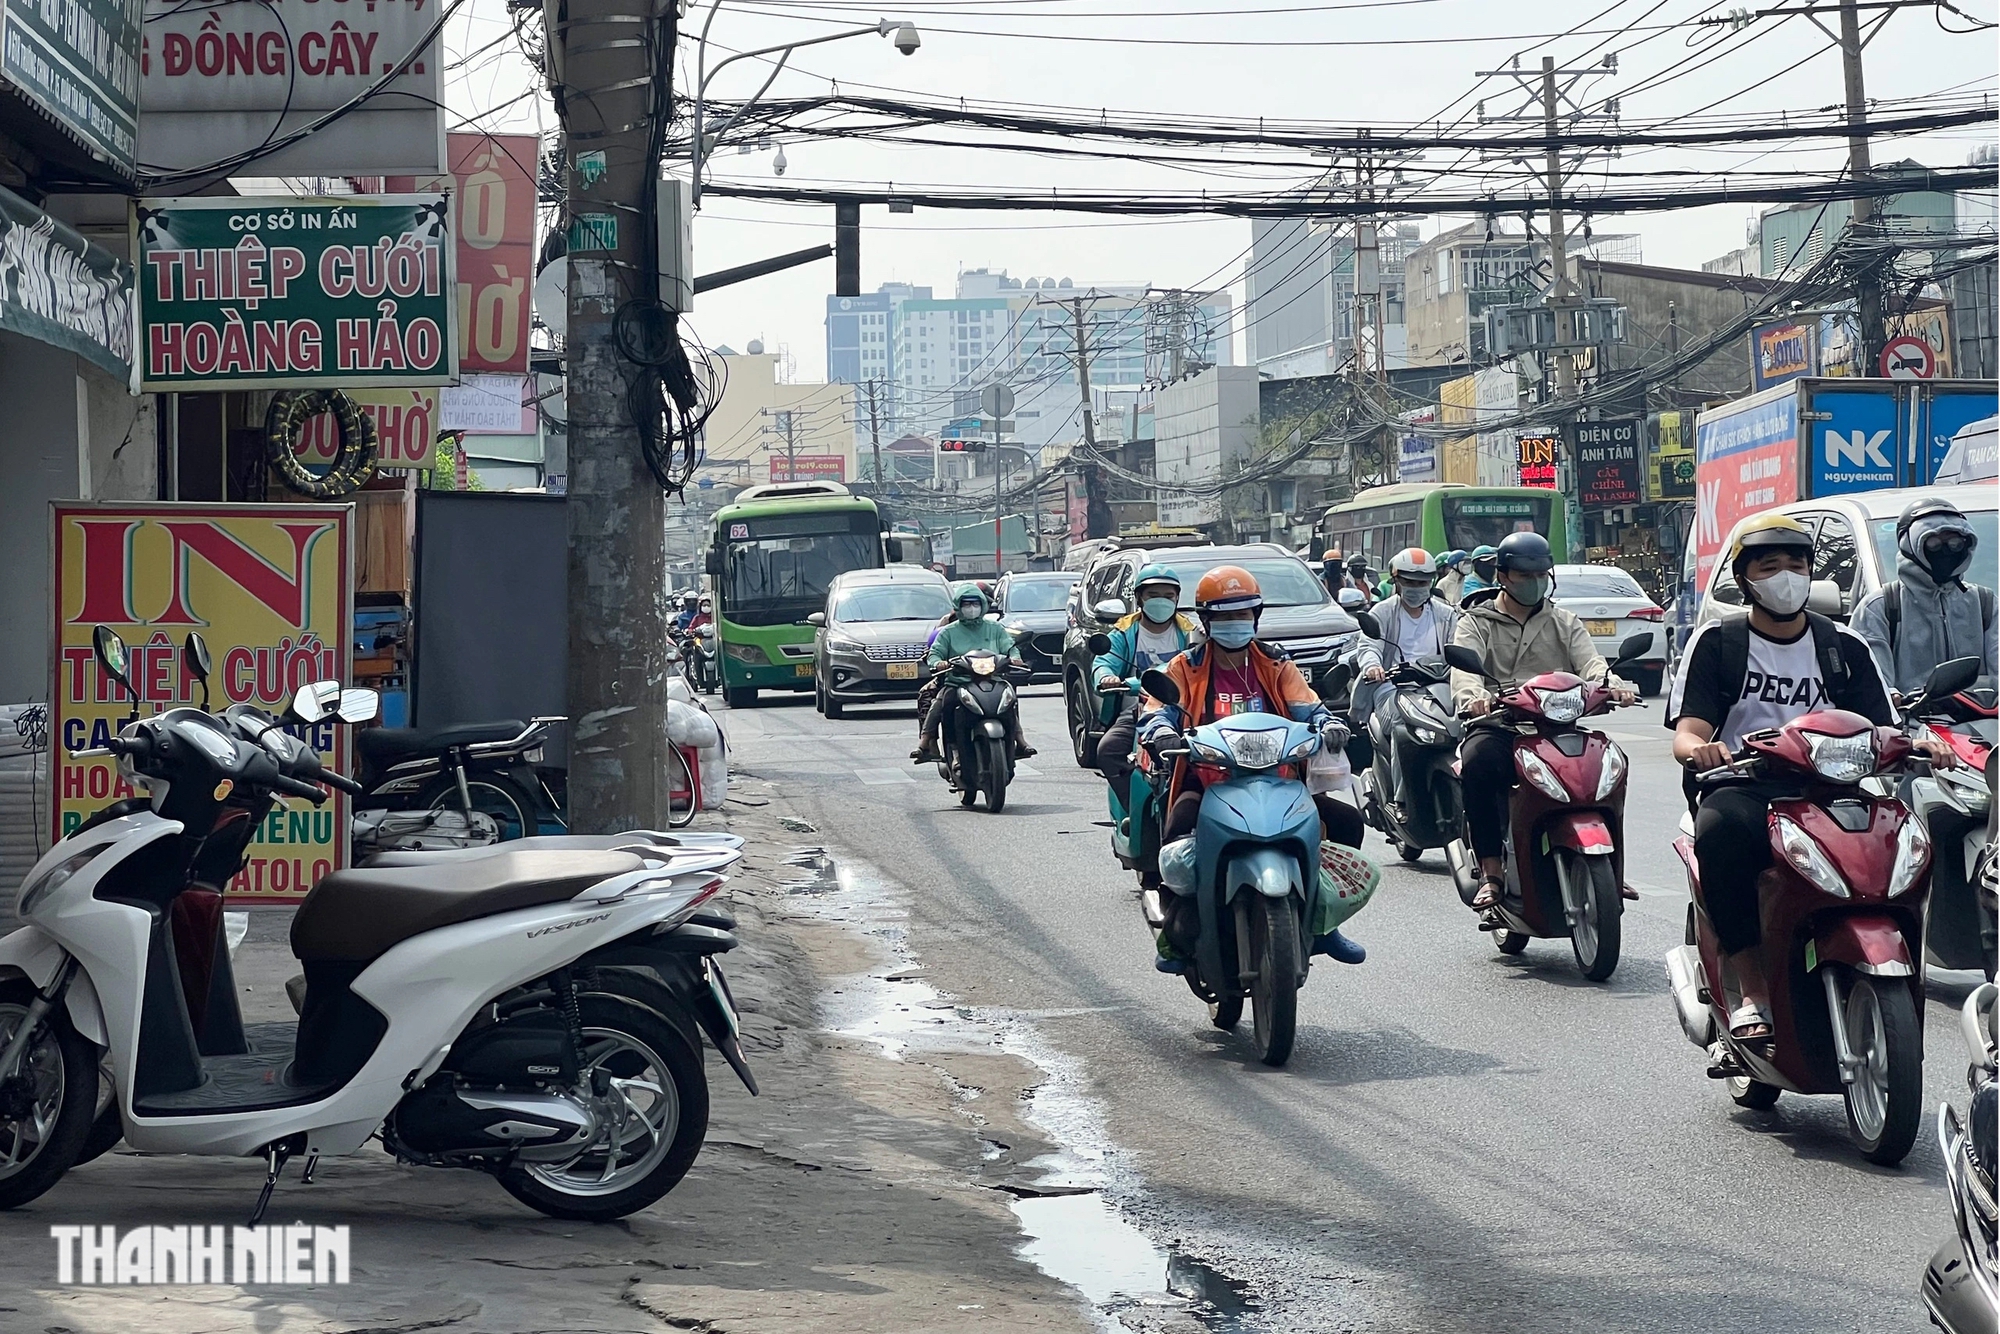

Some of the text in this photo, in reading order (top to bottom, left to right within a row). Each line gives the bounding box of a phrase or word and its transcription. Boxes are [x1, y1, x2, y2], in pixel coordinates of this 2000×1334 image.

[163, 12, 285, 76] ĐỒNG
[228, 206, 357, 232] CƠ SỞ IN ẤN
[147, 234, 306, 310] THIỆP
[319, 232, 440, 298] CƯỚI
[149, 299, 441, 376] HOÀNG HẢO
[1520, 439, 1553, 463] IN
[1579, 425, 1632, 444] ĐIỆN CƠ
[1825, 430, 1892, 467] NK
[1581, 444, 1633, 461] ANH TÂM
[1603, 491, 1636, 501] LASER
[1700, 478, 1721, 547] NK
[731, 525, 747, 537] 62
[66, 520, 336, 630] IN
[223, 632, 336, 704] CƯỚI
[231, 858, 331, 892] ATOLO
[526, 911, 612, 939] VISION
